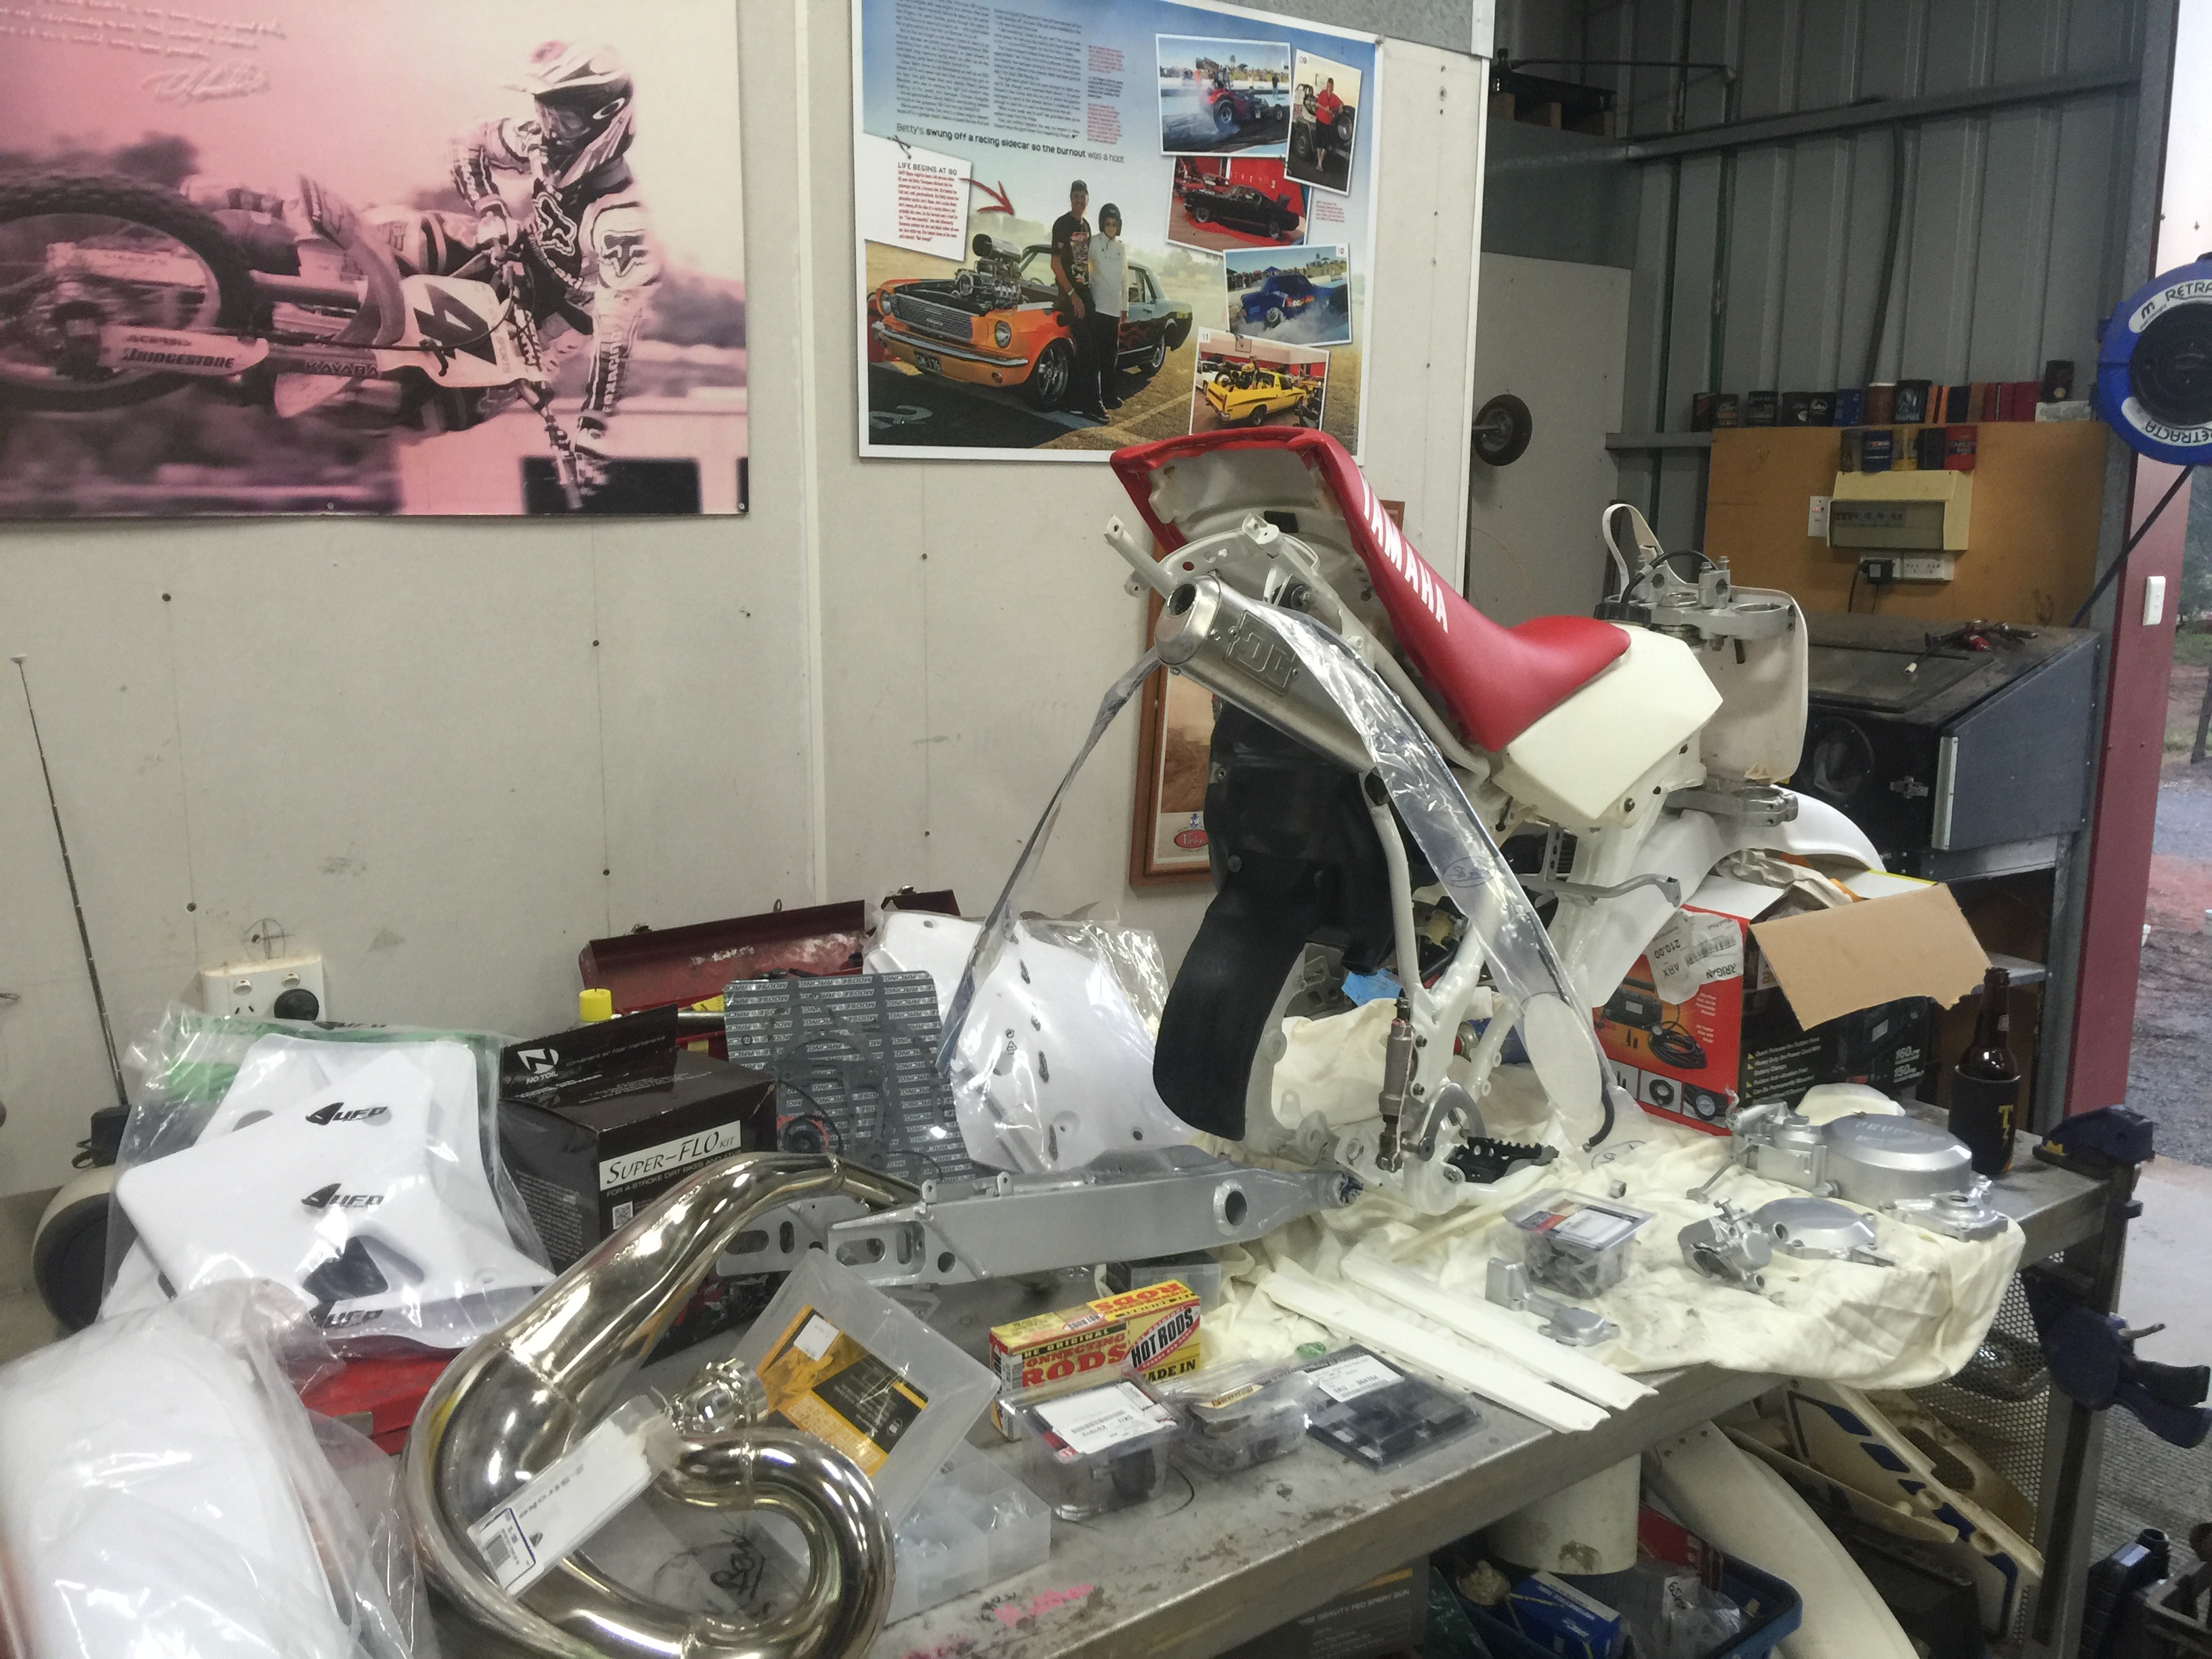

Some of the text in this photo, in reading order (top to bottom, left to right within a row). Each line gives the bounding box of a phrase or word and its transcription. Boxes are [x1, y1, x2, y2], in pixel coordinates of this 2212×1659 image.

[897, 123, 924, 135] Betty's
[926, 128, 952, 140] swung
[954, 132, 966, 140] off
[975, 136, 1000, 147] racing
[1002, 138, 1030, 149] sidecar
[1031, 143, 1041, 151] so
[1042, 144, 1055, 153] the
[1057, 146, 1086, 157] burnout
[1087, 152, 1102, 160] was
[913, 163, 937, 173] BEGINS
[306, 360, 380, 377] KAYABA
[2145, 420, 2212, 444] ETRACTA
[1654, 939, 1681, 959] 210.00
[541, 1070, 559, 1081] TOIL
[332, 1106, 388, 1122] UFO
[719, 1136, 735, 1148] KIT
[607, 1187, 623, 1197] FOR
[664, 1168, 681, 1179] DIRT
[1130, 1307, 1194, 1368] HOT RODS
[1023, 1349, 1040, 1359] HE
[1026, 1333, 1126, 1368] ONNECTING
[1022, 1343, 1127, 1389] RODS
[1145, 1359, 1196, 1382] ADE IN
